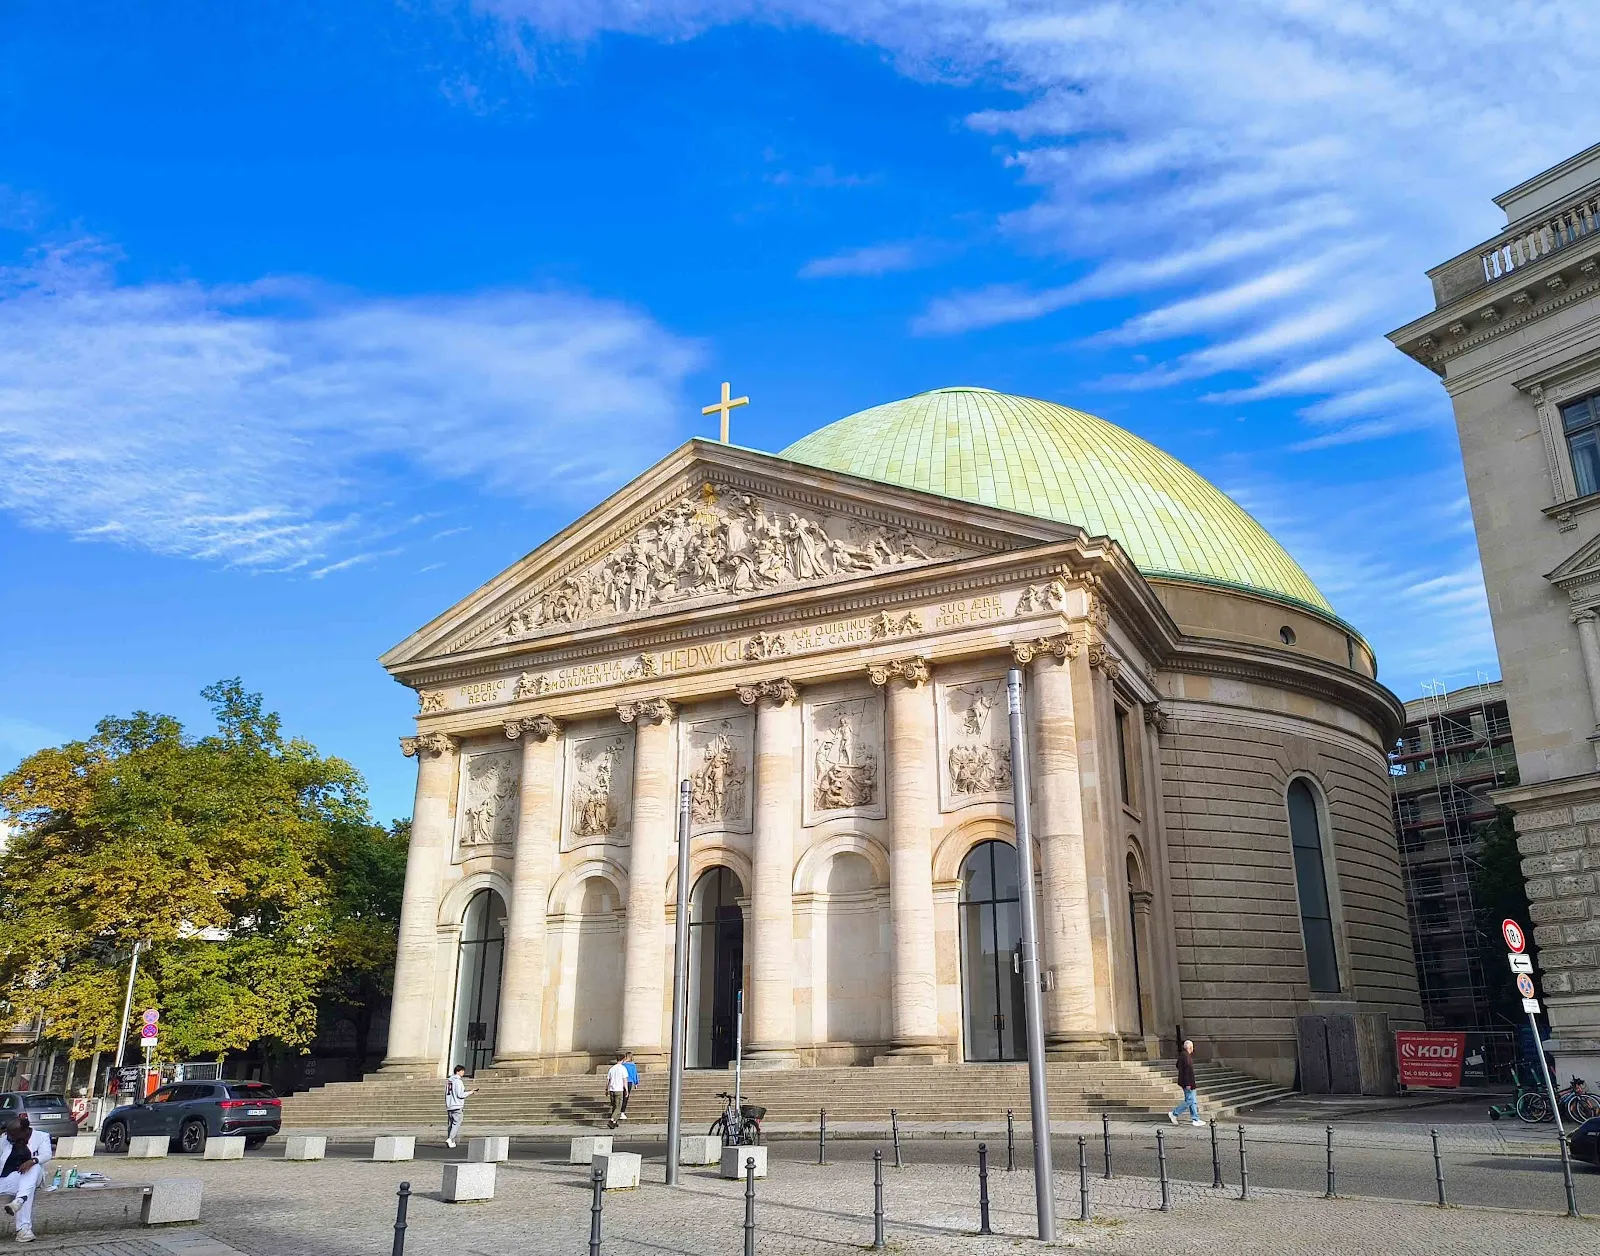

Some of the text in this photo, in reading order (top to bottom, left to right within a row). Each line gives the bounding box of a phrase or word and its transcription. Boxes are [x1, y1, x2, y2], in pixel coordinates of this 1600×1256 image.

[940, 602, 966, 615] SUO
[815, 617, 874, 636] QUIRINUS
[661, 639, 743, 672] HEDWIGI
[461, 680, 506, 696] FEDERICI
[551, 670, 627, 691] MONUMENTUM
[468, 692, 498, 704] REGIS
[79, 1103, 85, 1111] B
